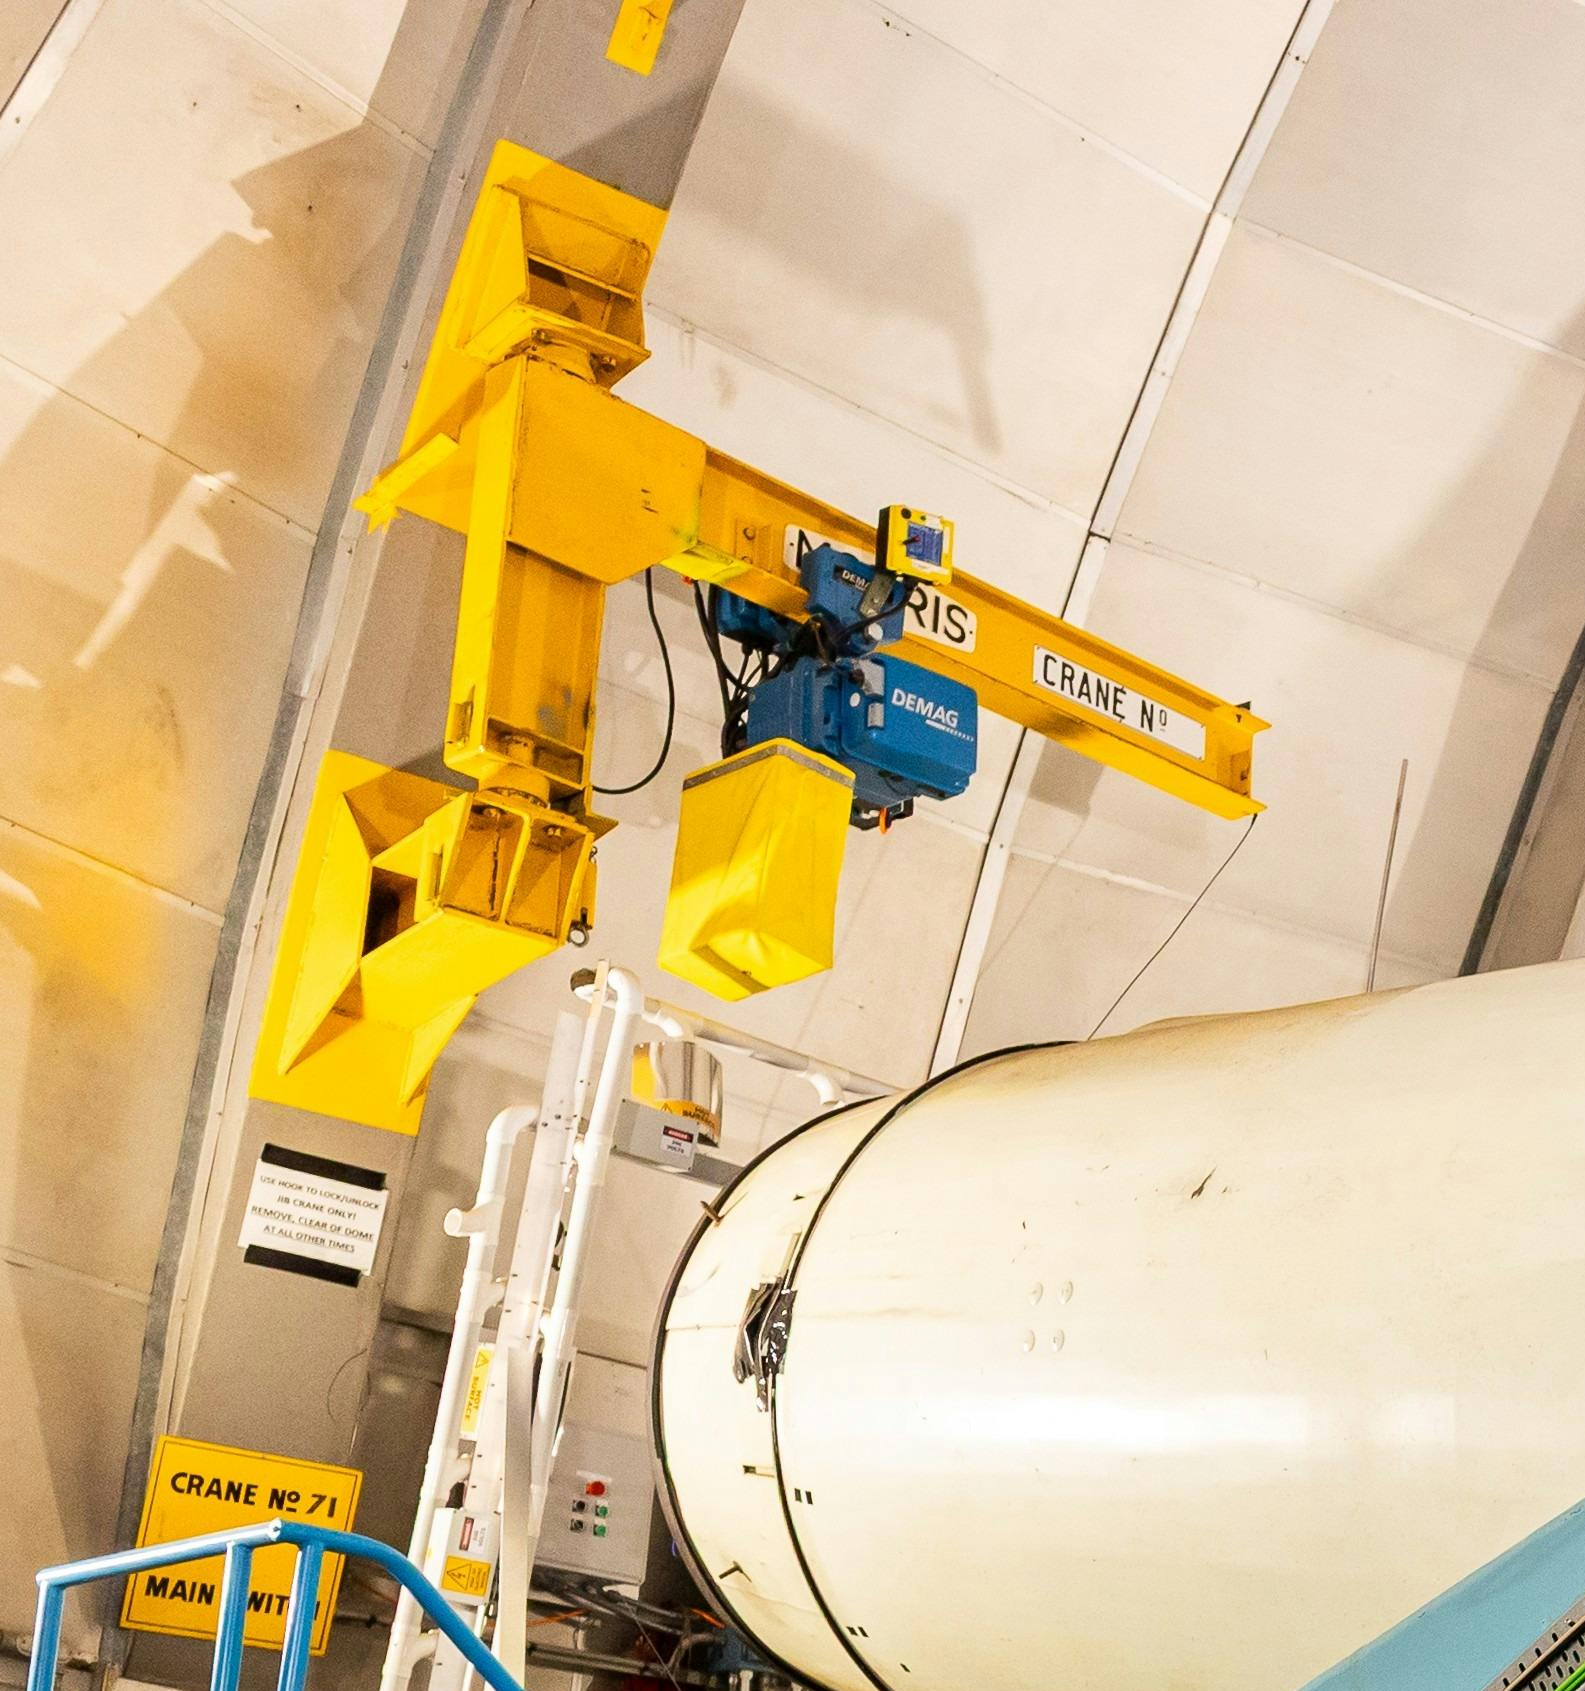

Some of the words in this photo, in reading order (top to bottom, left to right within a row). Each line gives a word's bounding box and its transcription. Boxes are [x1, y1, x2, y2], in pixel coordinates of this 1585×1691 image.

[842, 569, 870, 592] DEM
[1043, 654, 1126, 719] CRANE
[891, 687, 959, 730] DEMAG
[260, 1175, 276, 1185] USE
[278, 1180, 303, 1191] HOOK
[306, 1186, 318, 1195] TO
[319, 1190, 379, 1210] LOCK/UNLOCK
[292, 1199, 325, 1213] CRANE
[263, 1225, 276, 1234] AT
[278, 1228, 294, 1239] ALL
[296, 1232, 326, 1246] OTHER
[328, 1239, 355, 1253] TIMES
[298, 1216, 327, 1229] CLEAR
[329, 1223, 342, 1233] OF
[344, 1227, 374, 1242] DOME
[170, 1471, 259, 1506] CRANE
[305, 1493, 337, 1518] 71
[145, 1574, 216, 1606] MAIN
